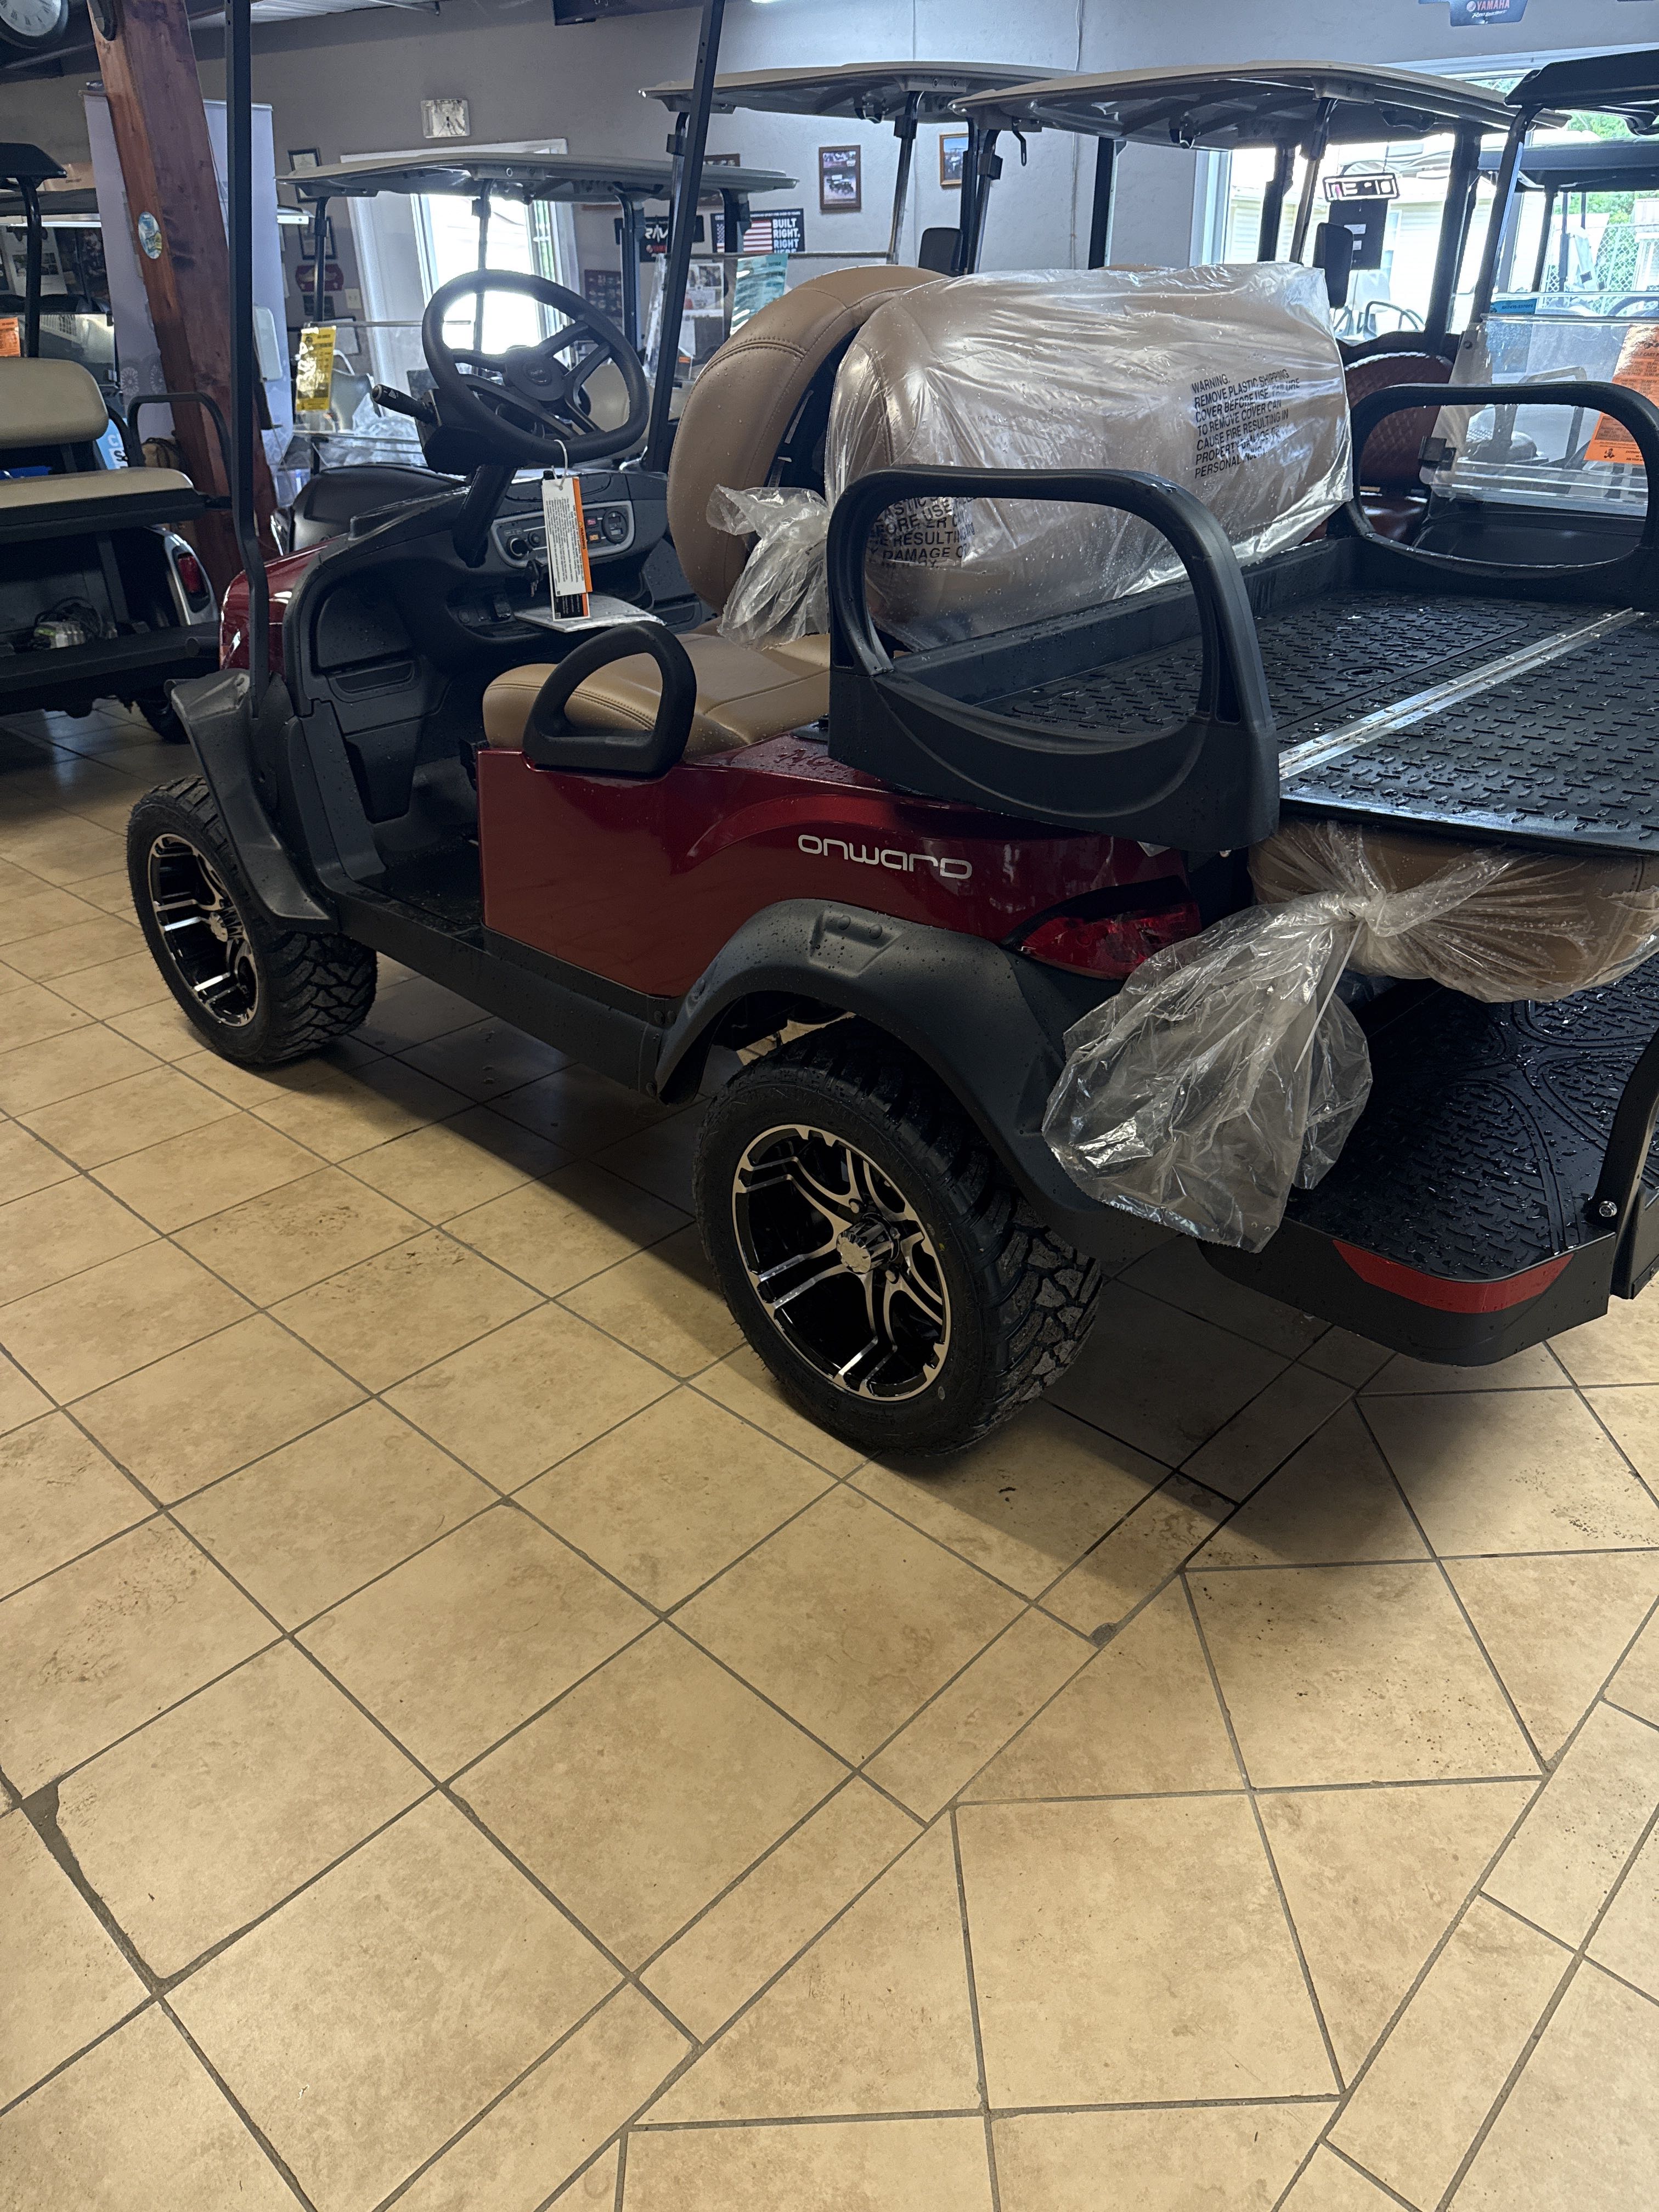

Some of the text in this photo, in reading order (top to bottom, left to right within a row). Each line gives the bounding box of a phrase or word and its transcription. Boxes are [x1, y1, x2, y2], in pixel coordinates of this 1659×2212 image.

[1477, 0, 1510, 10] YAMAHA
[772, 218, 797, 229] BUILT
[773, 228, 801, 238] RIGHT.
[774, 238, 799, 249] RIGHT
[1192, 374, 1231, 393] WARNING.
[1195, 369, 1289, 409] REMOVE PLASTIC SHIPPING
[1195, 404, 1222, 422] COVER
[1224, 393, 1254, 412] BEFORE
[1198, 399, 1282, 437] TO REMOVE COVER CAN
[1197, 408, 1289, 451] CAUSE FIRE RESULTING IN
[1195, 441, 1239, 465] PROPERTY
[1195, 454, 1241, 479] PERSONAL
[883, 547, 951, 562] DAMAGE
